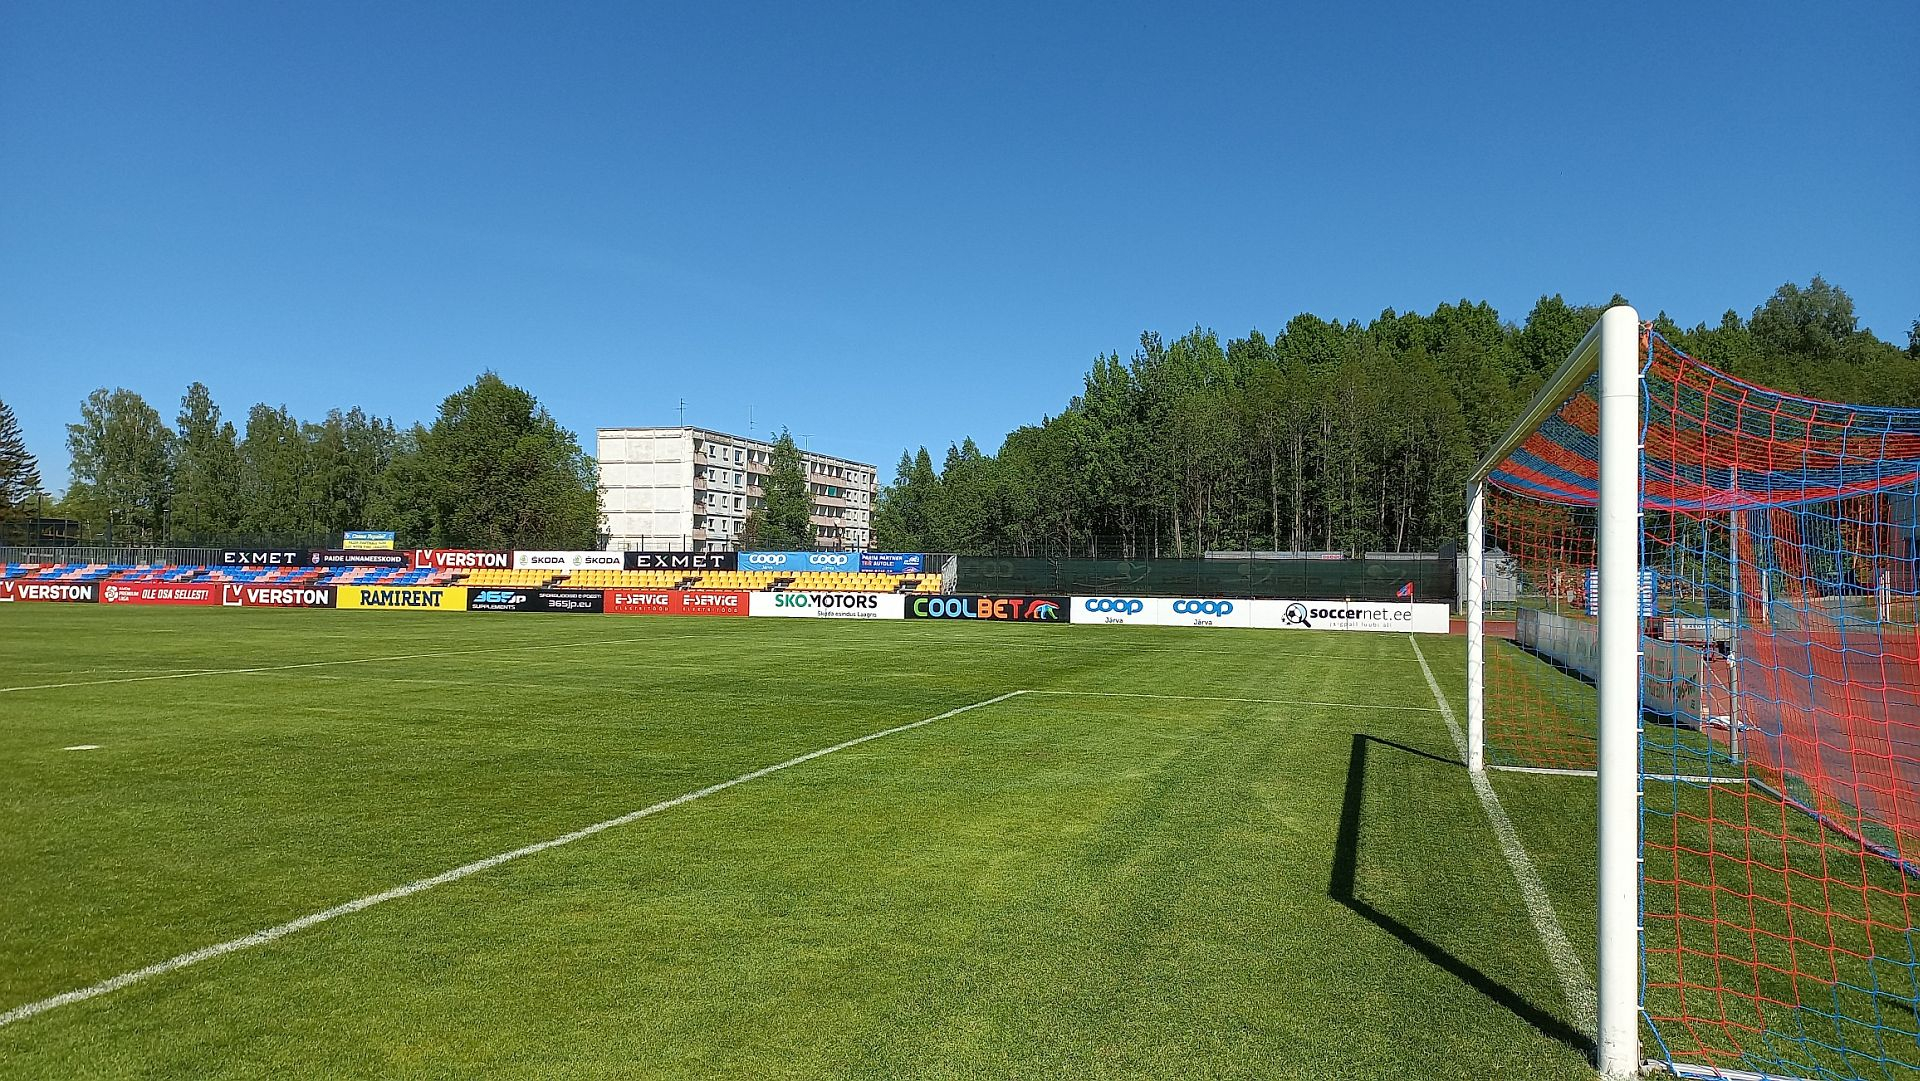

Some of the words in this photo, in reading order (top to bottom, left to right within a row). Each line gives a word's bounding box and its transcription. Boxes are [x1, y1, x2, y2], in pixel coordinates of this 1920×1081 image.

[224, 551, 297, 565] EXMET
[324, 554, 344, 563] PAIDE
[345, 554, 402, 564] LINNAMEESKOND
[436, 551, 508, 568] VERSTON
[531, 554, 565, 565] ŠKODA
[585, 555, 621, 566] ŠKODA
[637, 555, 725, 569] EXMET
[748, 553, 787, 566] coop
[809, 554, 848, 567] coop
[18, 584, 93, 601] VERSTON
[142, 589, 157, 600] OLE
[157, 589, 173, 600] OSA
[174, 590, 209, 601] SELLEST!
[247, 588, 329, 606] VERSTON
[360, 589, 444, 607] RAMIRENT
[775, 593, 878, 609] SKO.MOTORS
[913, 597, 1024, 619] COOLBET
[1085, 598, 1144, 616] coop
[1173, 599, 1233, 617] coop
[1104, 616, 1124, 624] Järva
[1310, 606, 1412, 622] soccernet.ee
[1193, 618, 1213, 626] Järva
